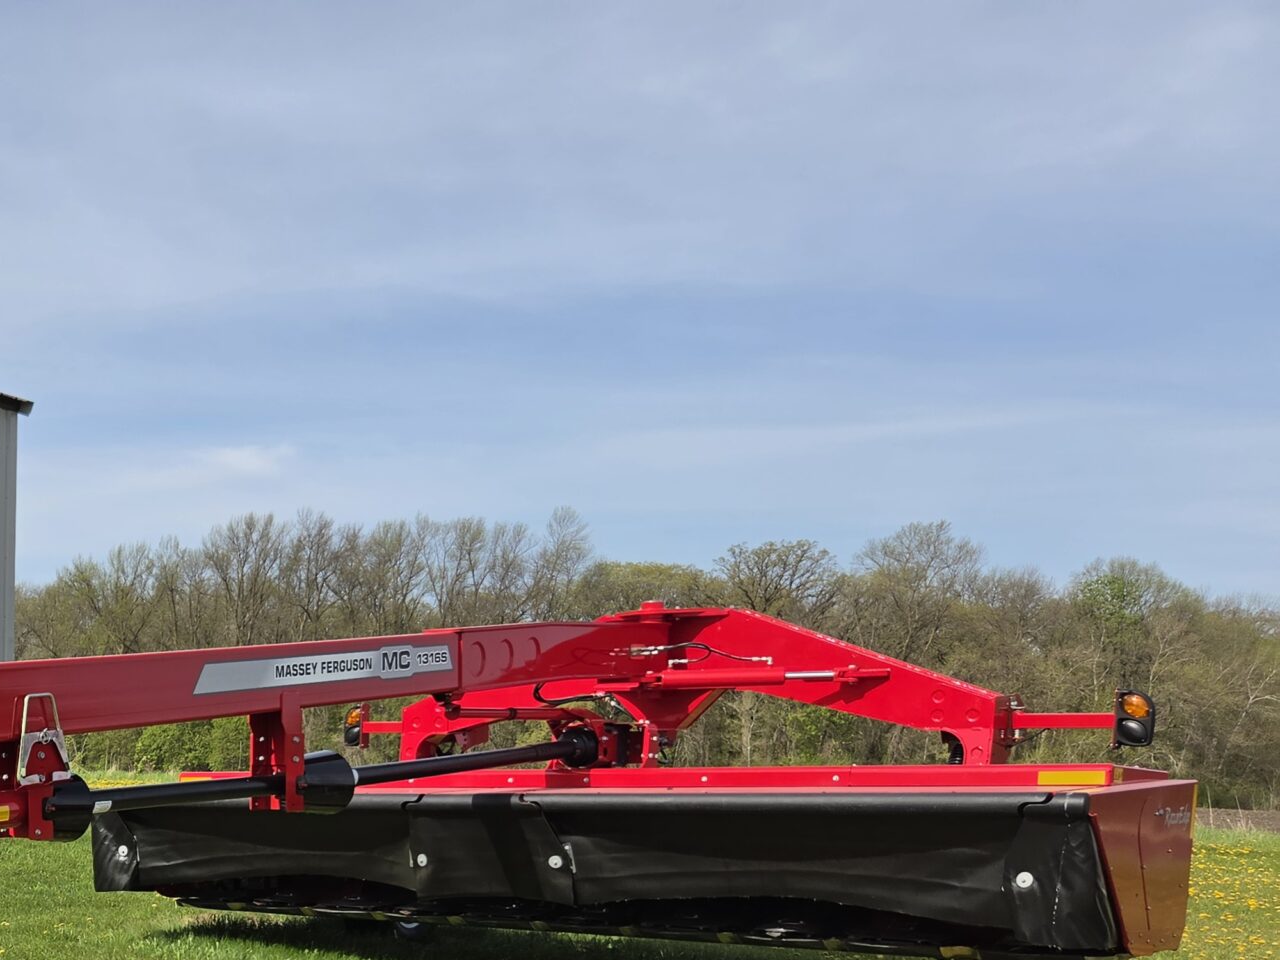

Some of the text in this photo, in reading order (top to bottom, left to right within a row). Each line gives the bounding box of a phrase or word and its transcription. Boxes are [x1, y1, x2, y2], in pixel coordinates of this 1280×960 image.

[275, 650, 448, 678] MASSEY FERGUSON MC 1316S
